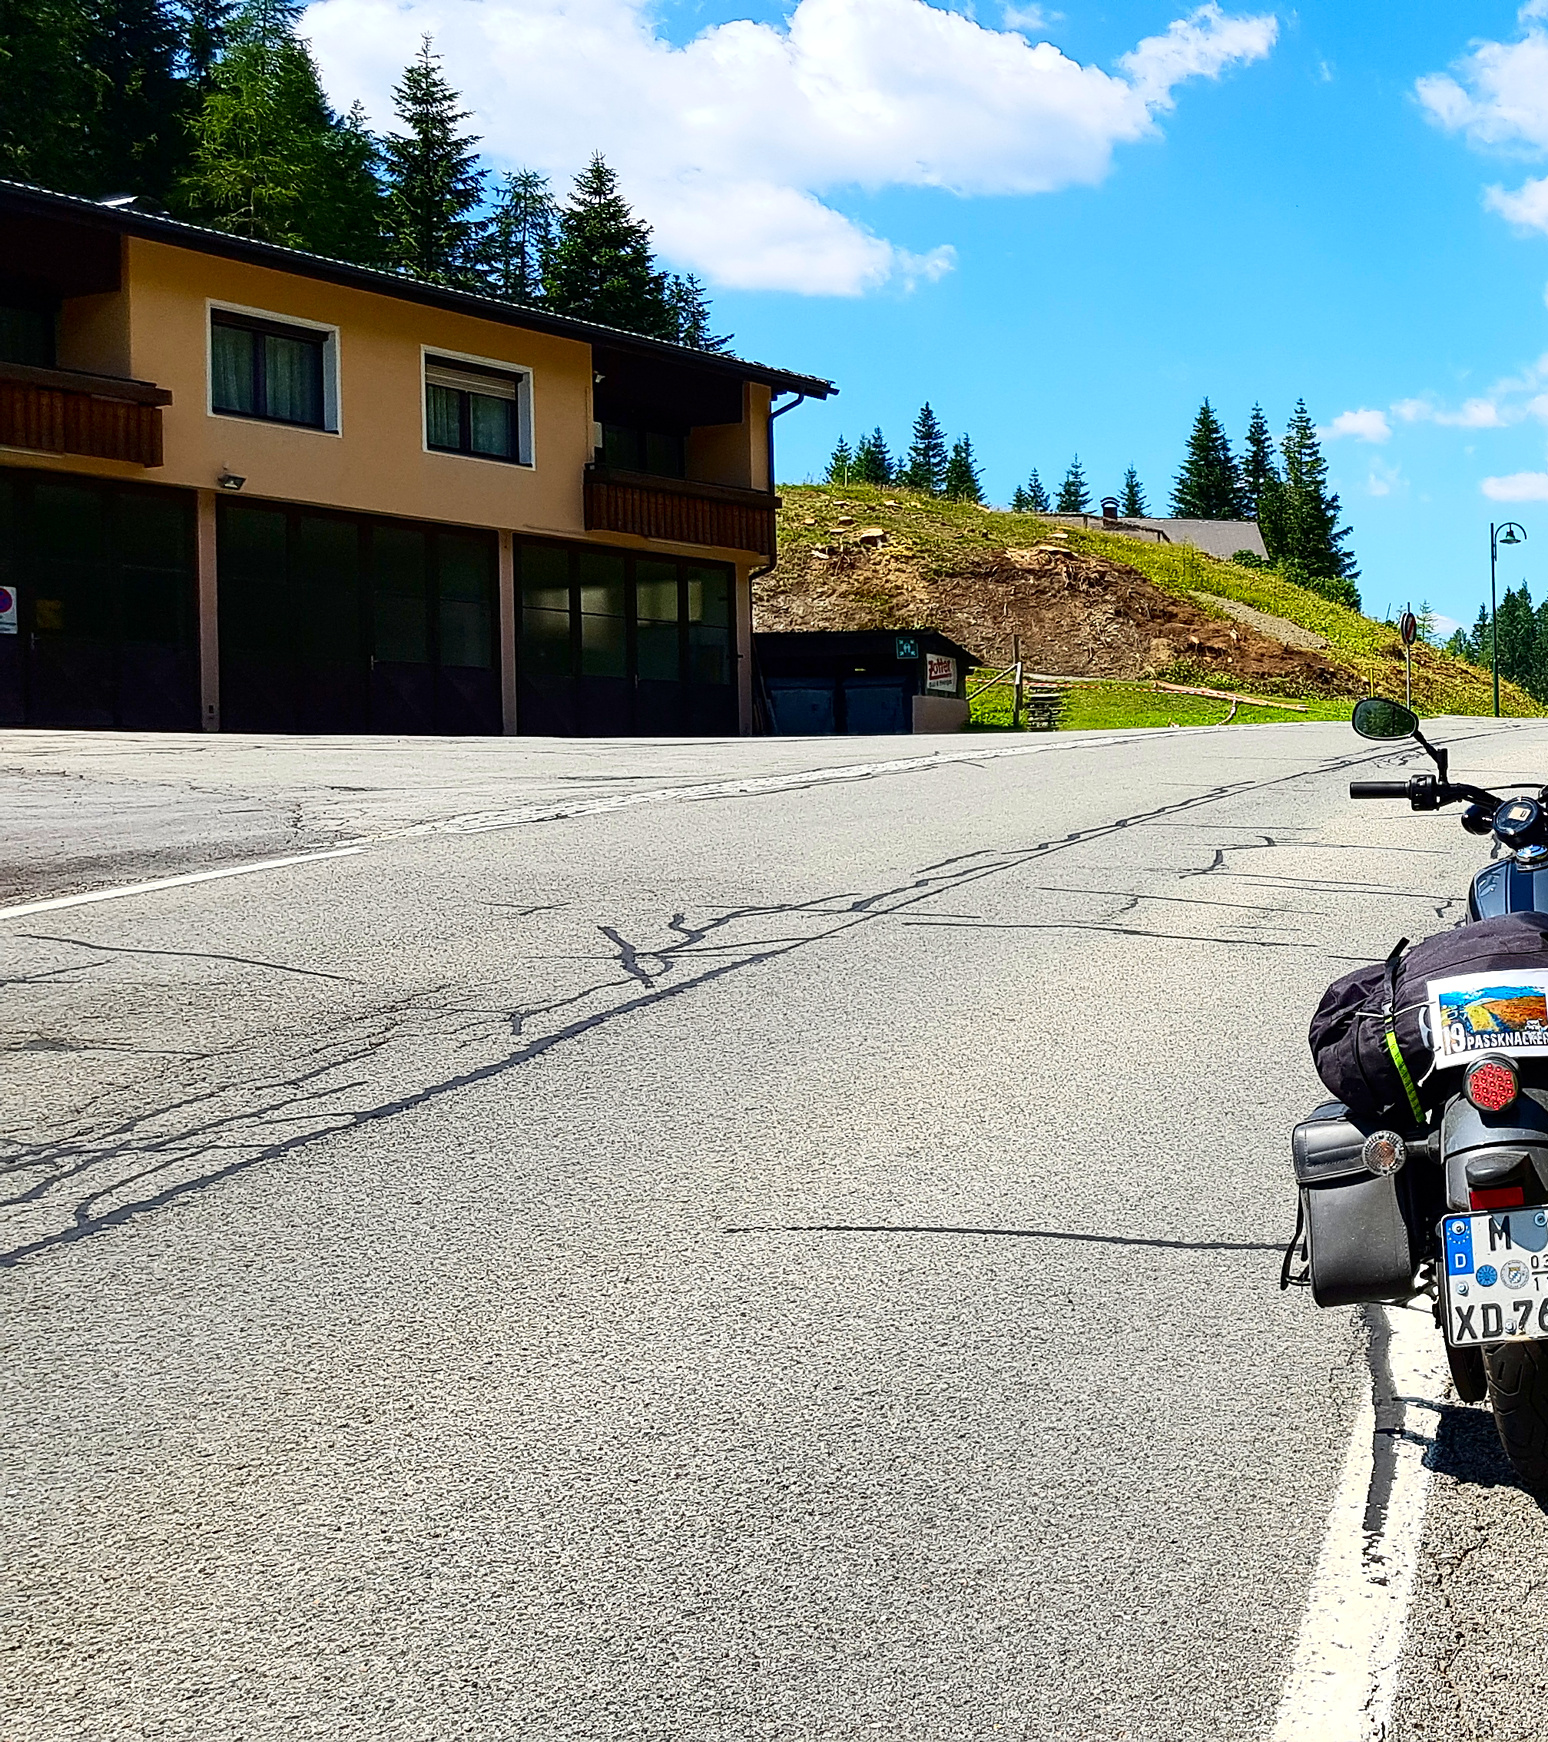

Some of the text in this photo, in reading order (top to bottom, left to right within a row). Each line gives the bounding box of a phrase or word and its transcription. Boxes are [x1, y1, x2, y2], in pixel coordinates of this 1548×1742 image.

[1442, 1022, 1466, 1055] 19
[1488, 1215, 1512, 1251] M
[1454, 1253, 1467, 1268] D
